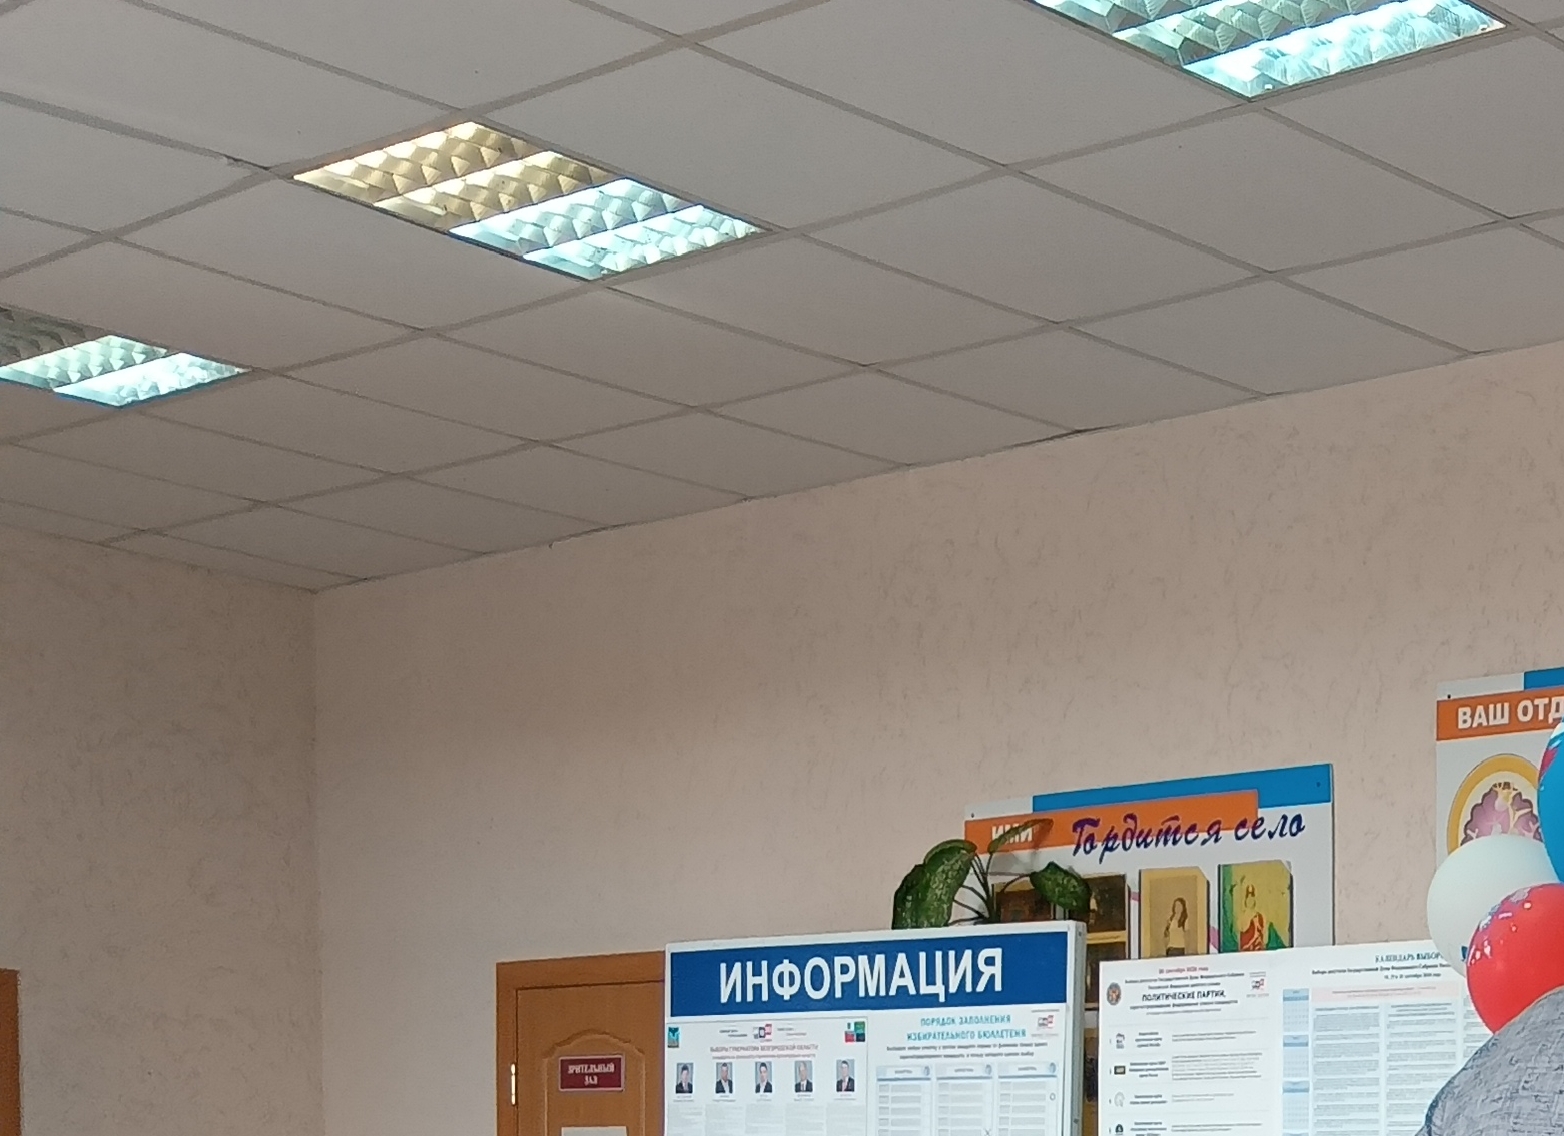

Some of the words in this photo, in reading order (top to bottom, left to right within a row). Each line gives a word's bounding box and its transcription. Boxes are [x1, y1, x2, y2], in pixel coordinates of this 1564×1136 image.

[1457, 702, 1510, 729] ВАШ
[1072, 812, 1222, 864] Гордится
[1234, 813, 1306, 841] село
[1416, 952, 1443, 960] ВЫБОР
[719, 948, 1003, 1004] ИНФОРМАЦИЯ
[920, 1017, 956, 1027] ПОРЯДОК
[959, 1014, 1011, 1025] ЗАПОЛНЕНИЯ
[907, 1030, 975, 1042] ИЗБИРАТЕЛЬНОГО
[978, 1029, 1026, 1039] БЮЛЛЕТЕНЯ
[568, 1063, 615, 1074] ЗРИТЕЛЬНЫЙ
